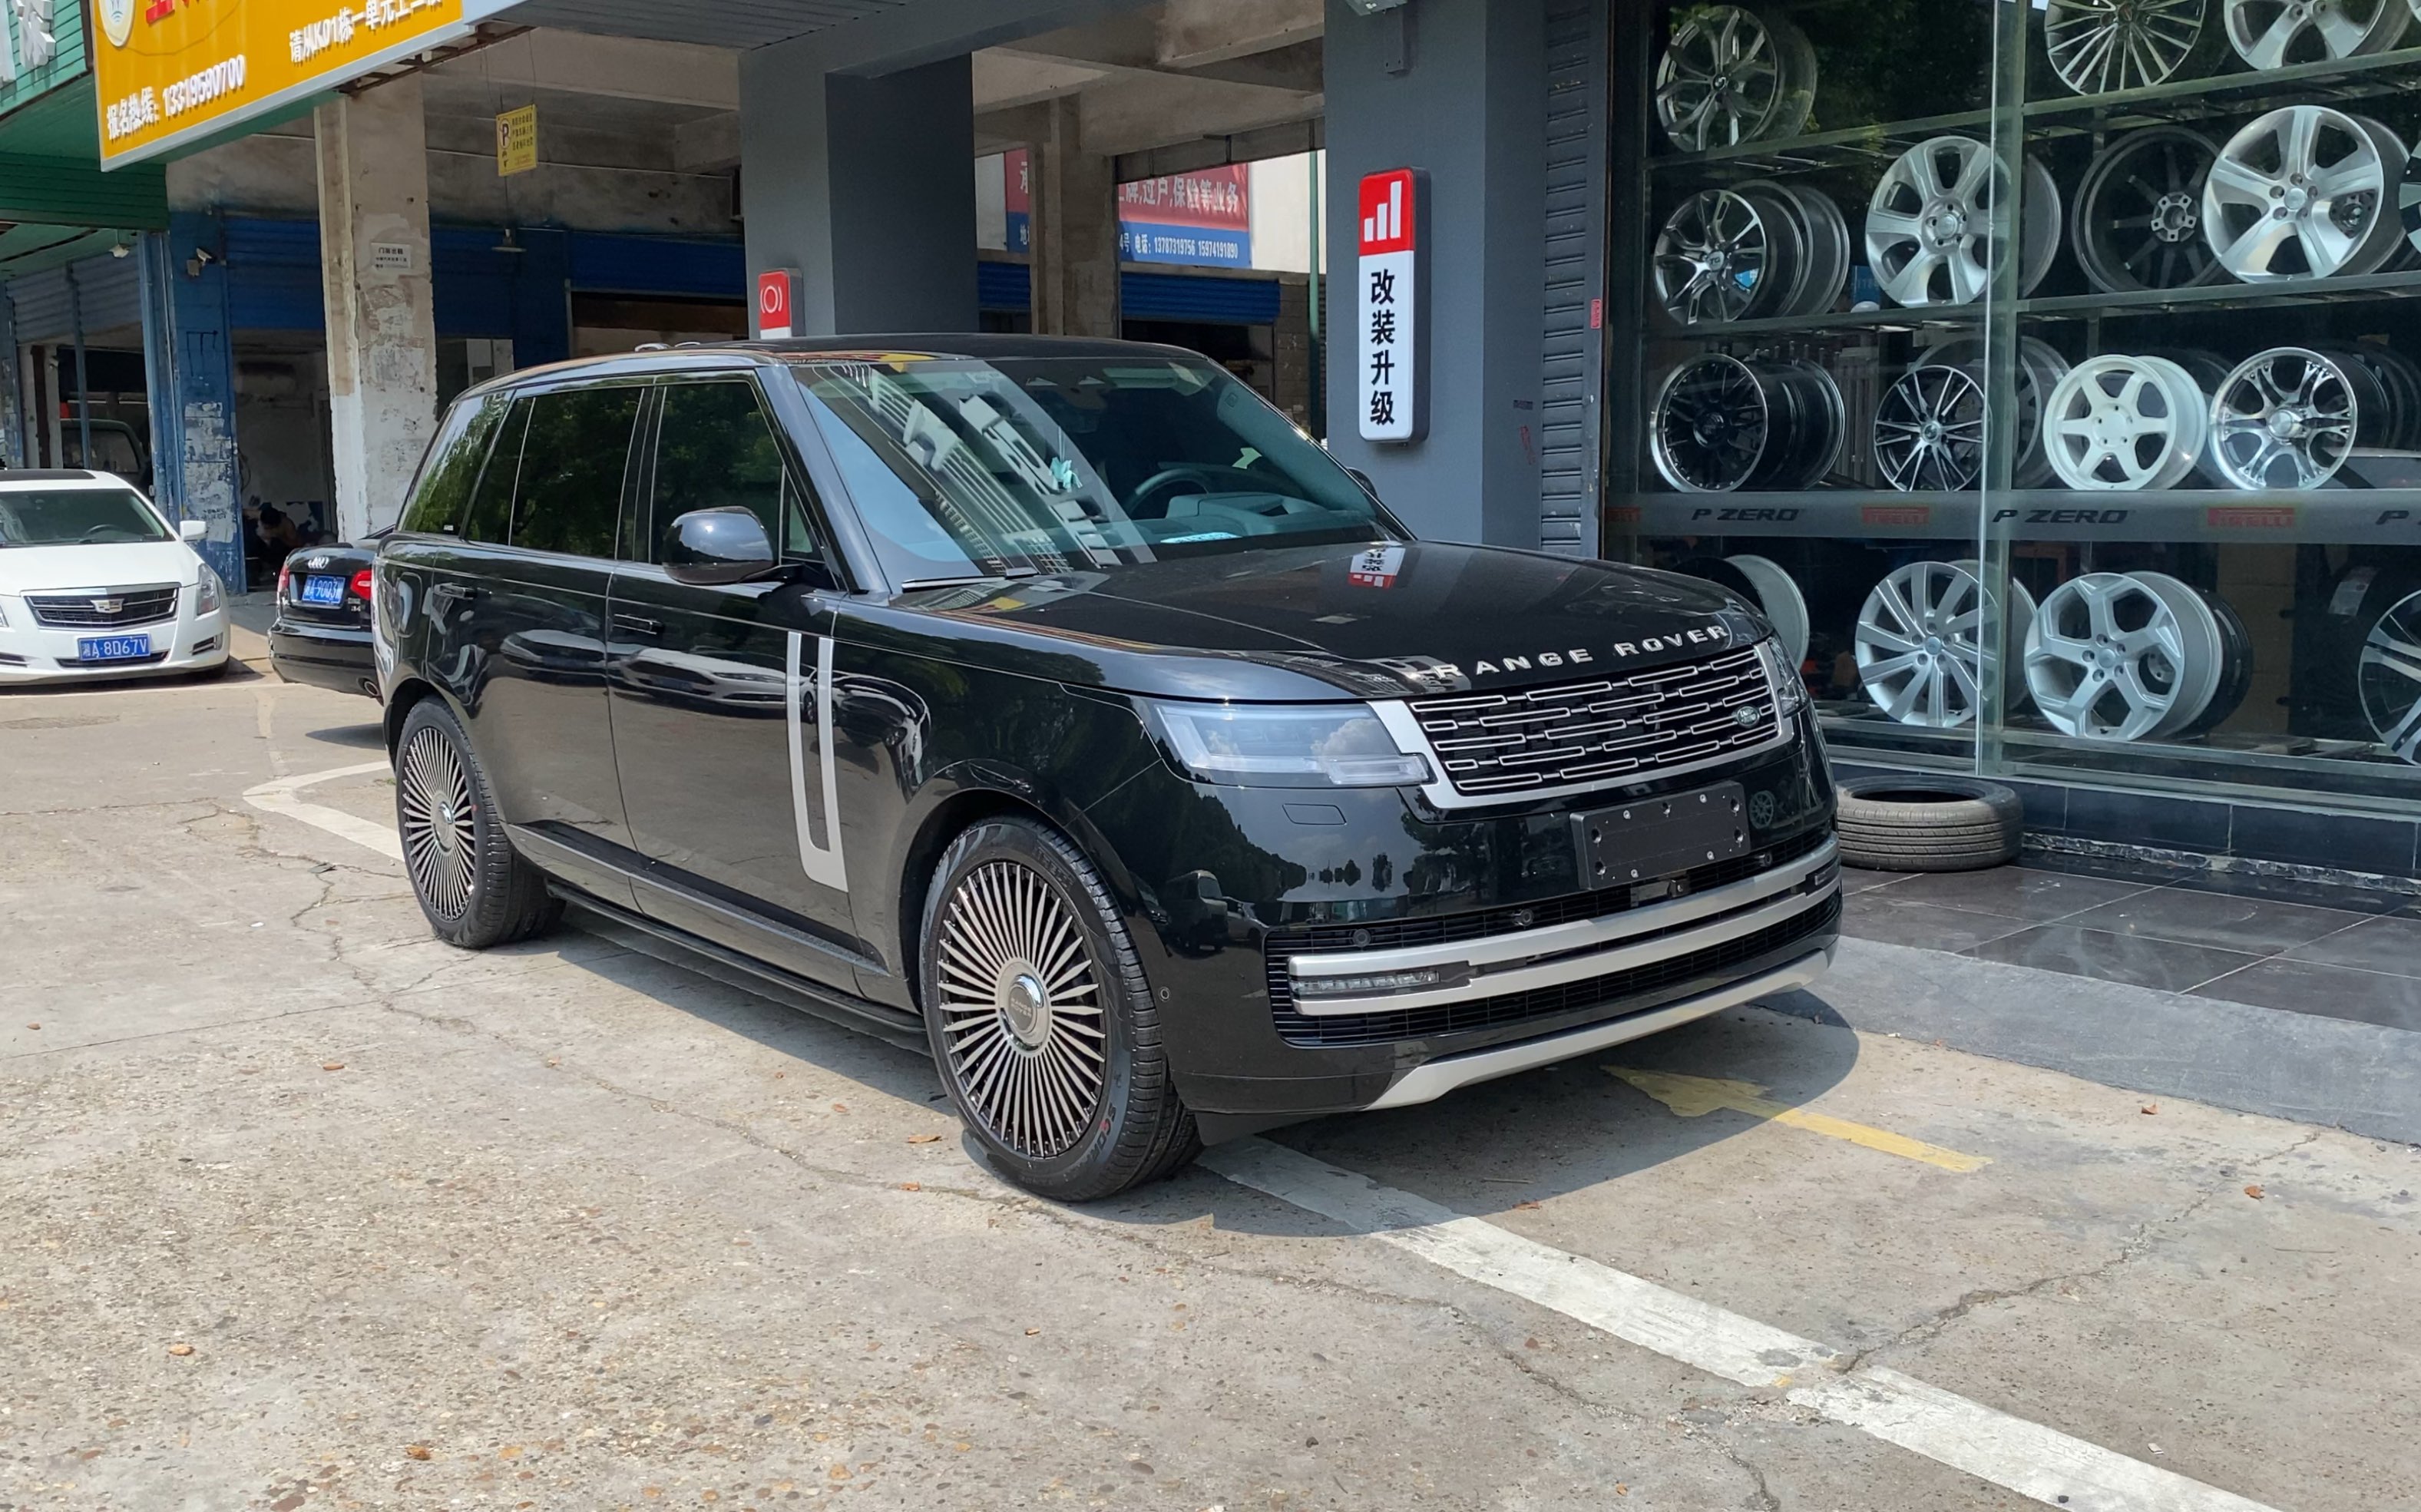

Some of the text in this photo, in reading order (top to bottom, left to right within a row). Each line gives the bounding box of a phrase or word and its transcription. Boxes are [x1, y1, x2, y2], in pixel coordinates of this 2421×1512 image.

[162, 54, 245, 117] 13319590700
[1119, 176, 1238, 213] 牌,过户,保险等业务
[1154, 237, 1196, 256] 13787319756
[1370, 268, 1396, 426] 改装升级
[1692, 508, 1800, 521] P ZERO
[1993, 510, 2128, 523] P ZERO
[1431, 624, 1729, 680] RANGE ROVER
